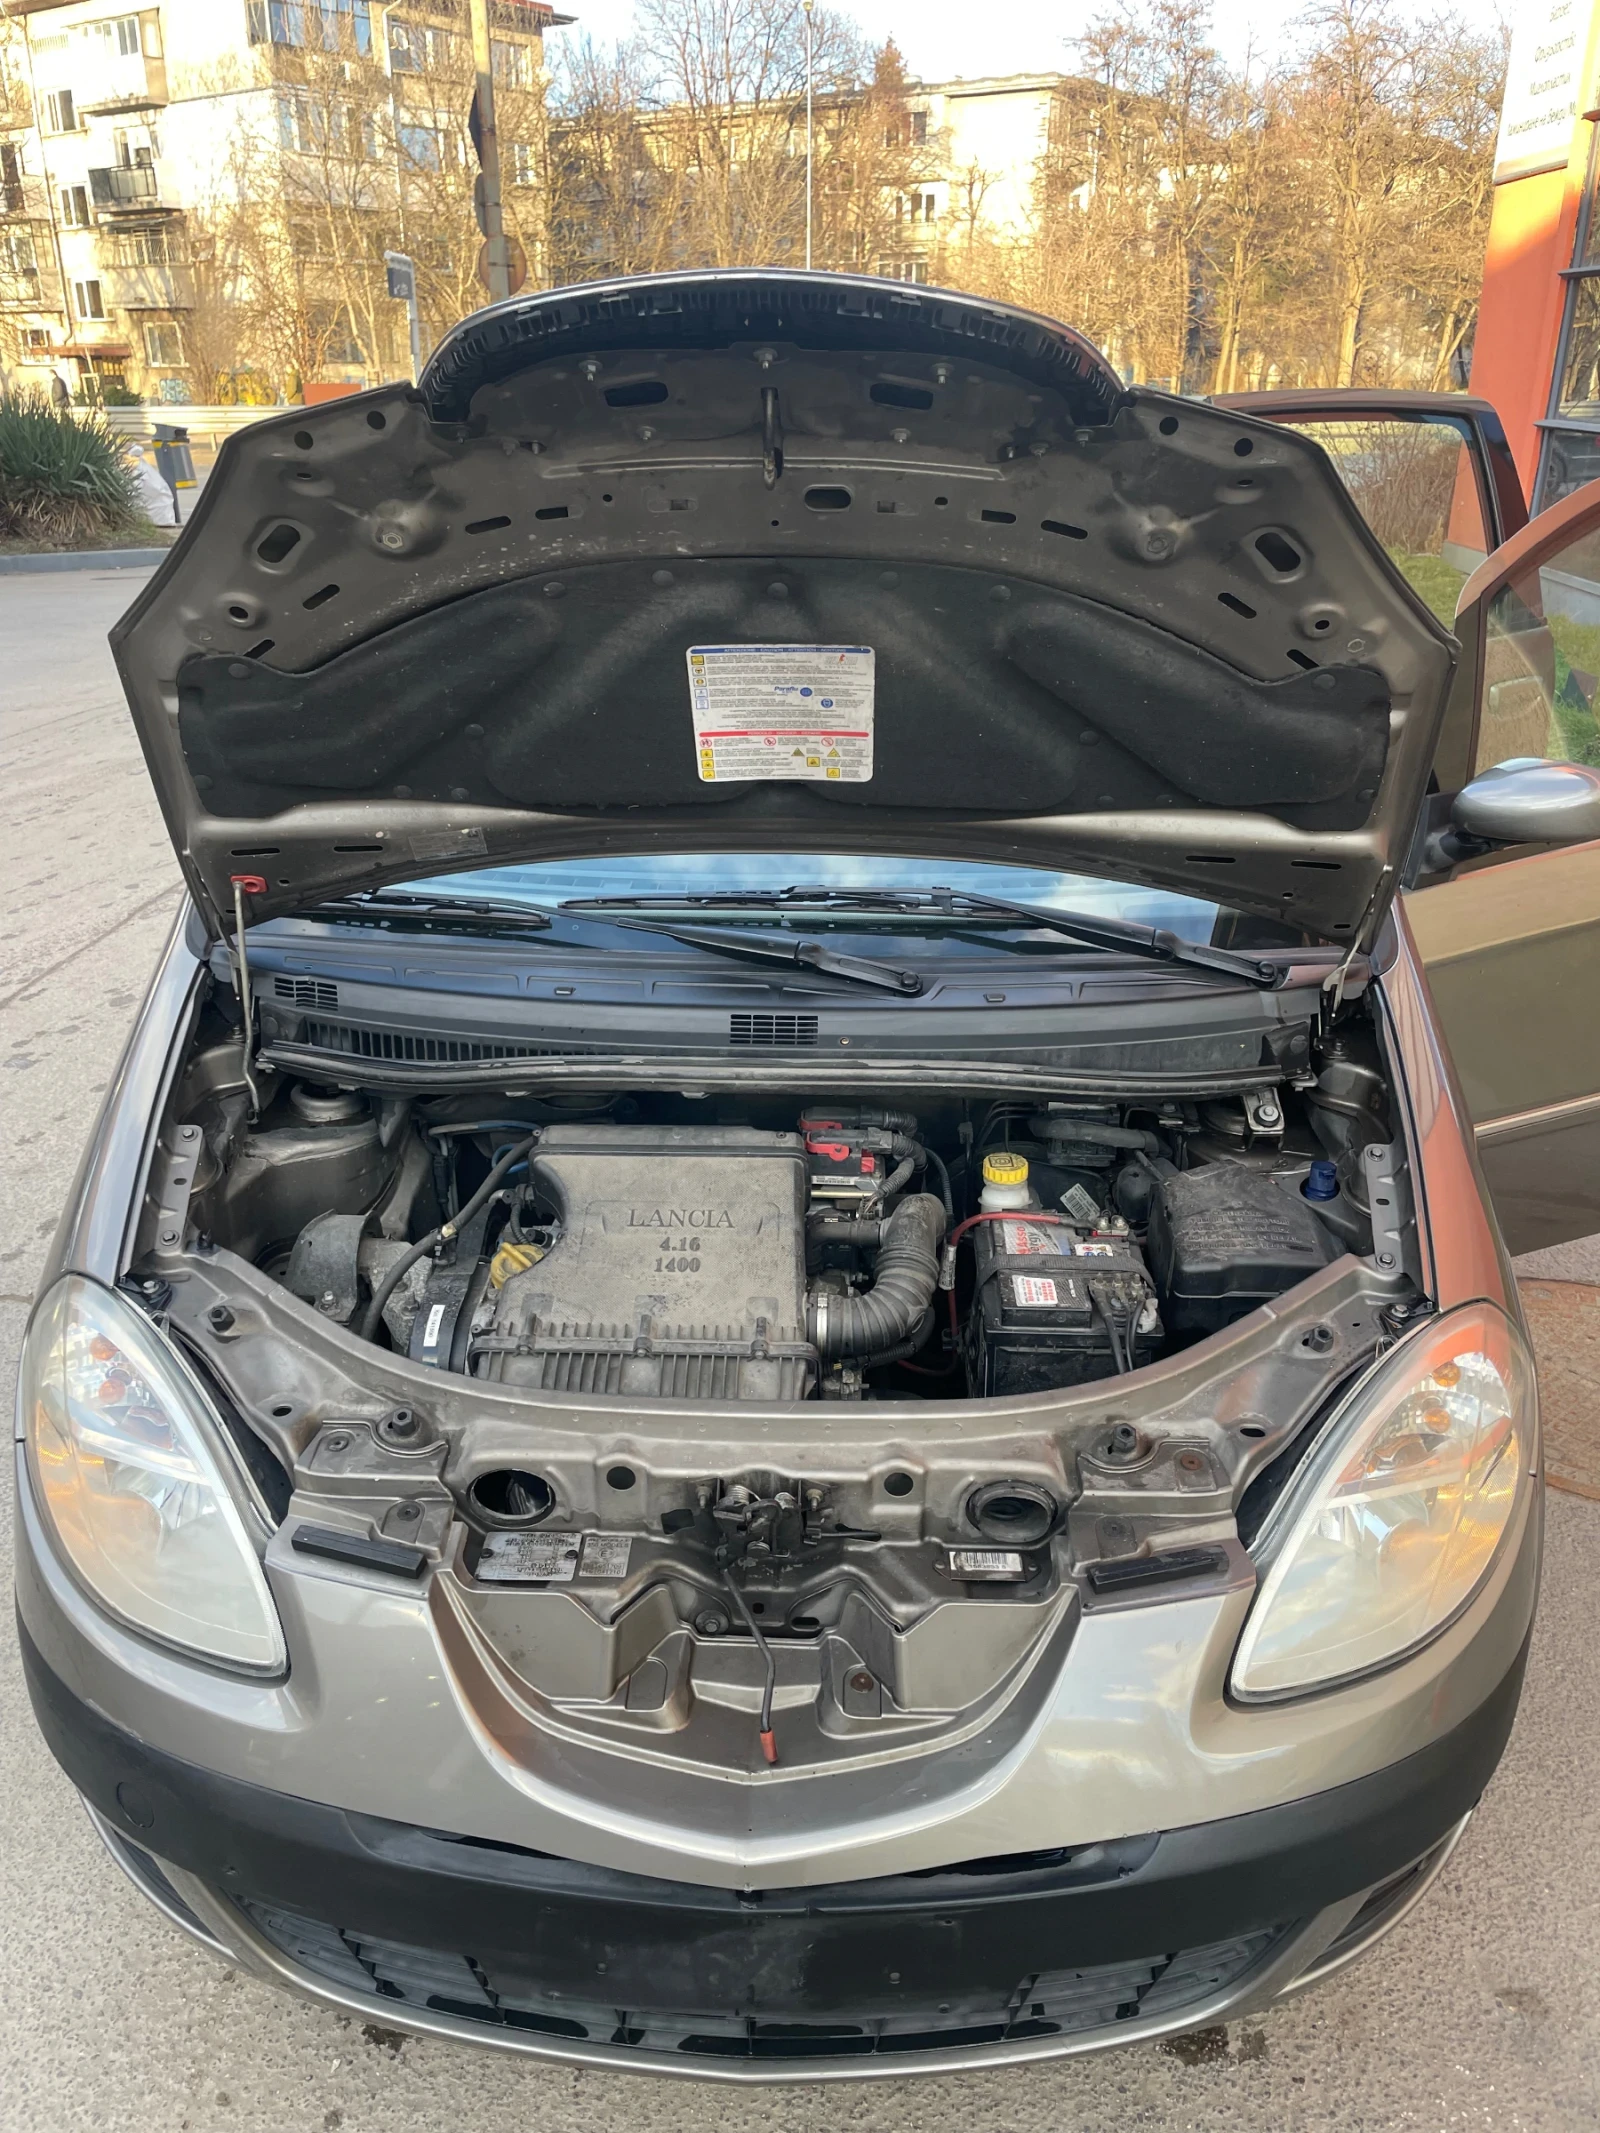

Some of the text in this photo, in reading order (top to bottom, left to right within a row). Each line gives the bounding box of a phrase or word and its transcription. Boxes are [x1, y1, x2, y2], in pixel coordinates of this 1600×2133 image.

[627, 1208, 735, 1229] LANCIA
[660, 1237, 701, 1252] 4.16
[654, 1257, 701, 1272] 1400
